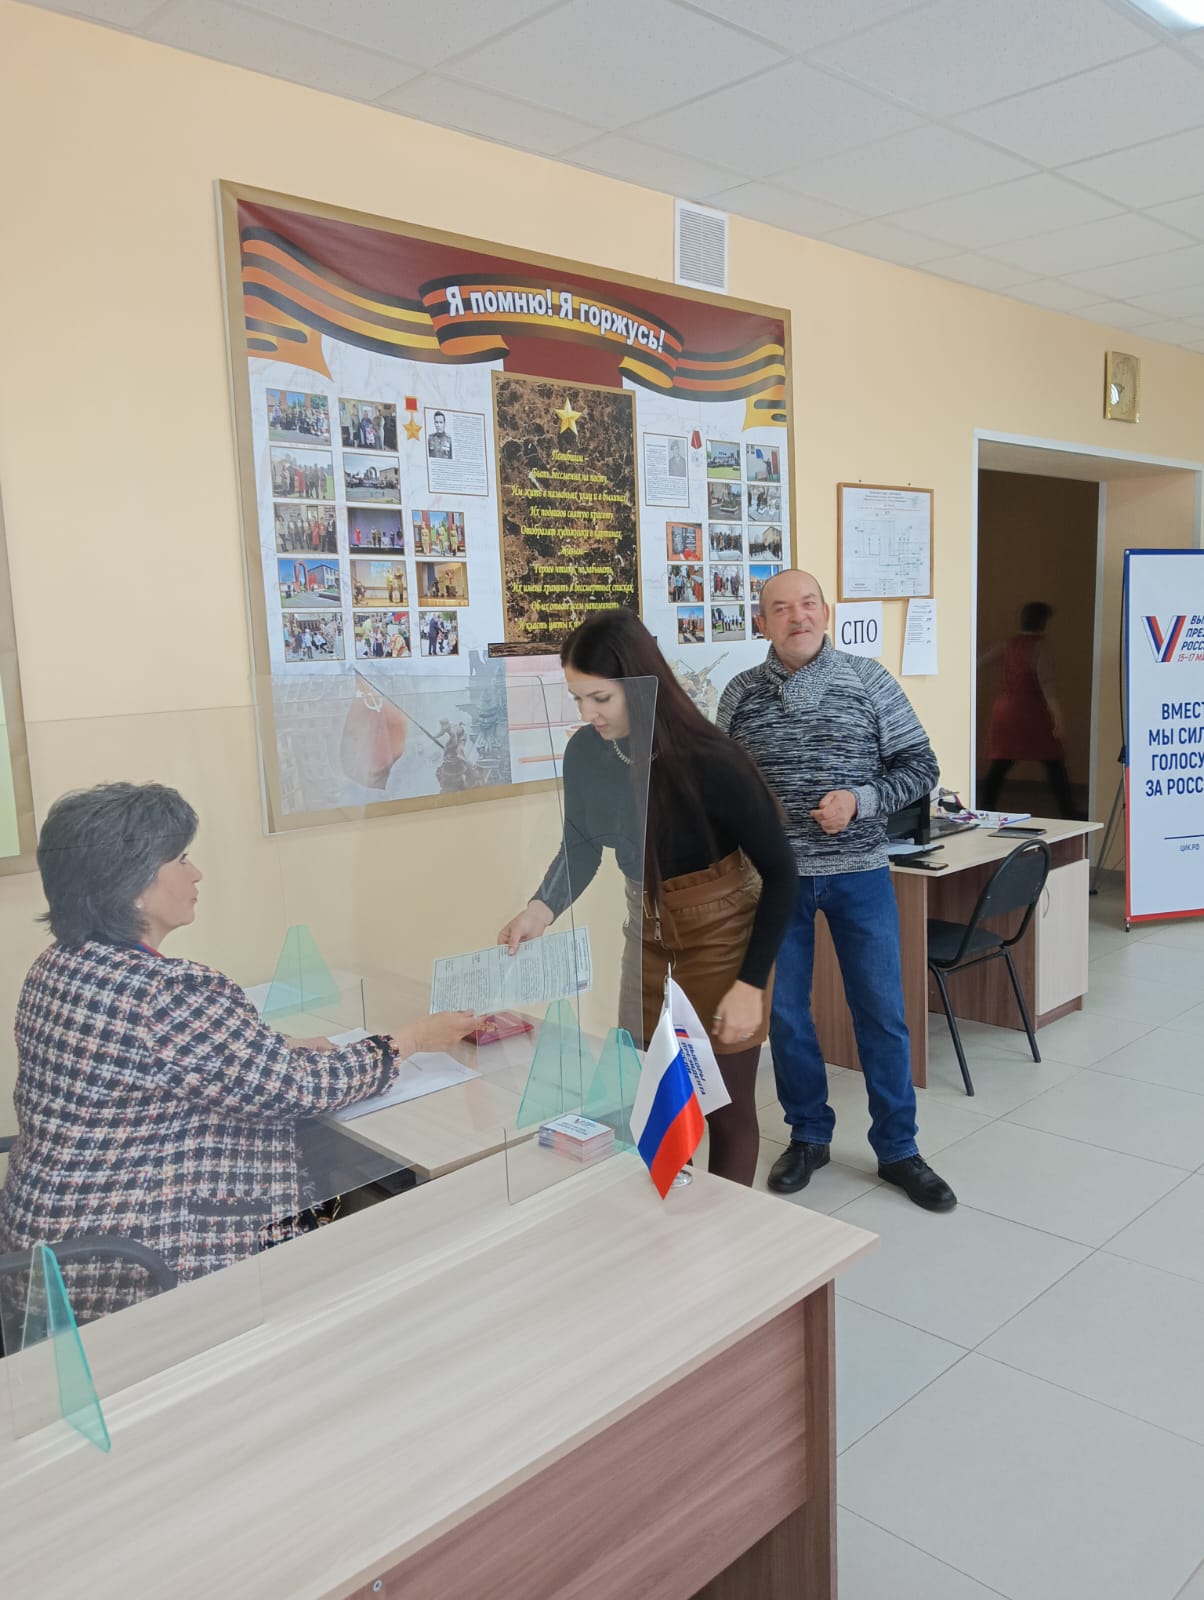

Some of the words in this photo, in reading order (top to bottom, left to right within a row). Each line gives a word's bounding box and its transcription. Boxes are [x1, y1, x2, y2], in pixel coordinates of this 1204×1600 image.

[445, 285, 465, 317] Я
[470, 288, 553, 317] помню!
[559, 292, 573, 320] Я
[579, 303, 666, 353] горжусь!
[841, 619, 878, 645] СПО
[1148, 727, 1174, 746] МЫ
[1145, 779, 1163, 797] ЗА
[1167, 776, 1204, 796] РОСС
